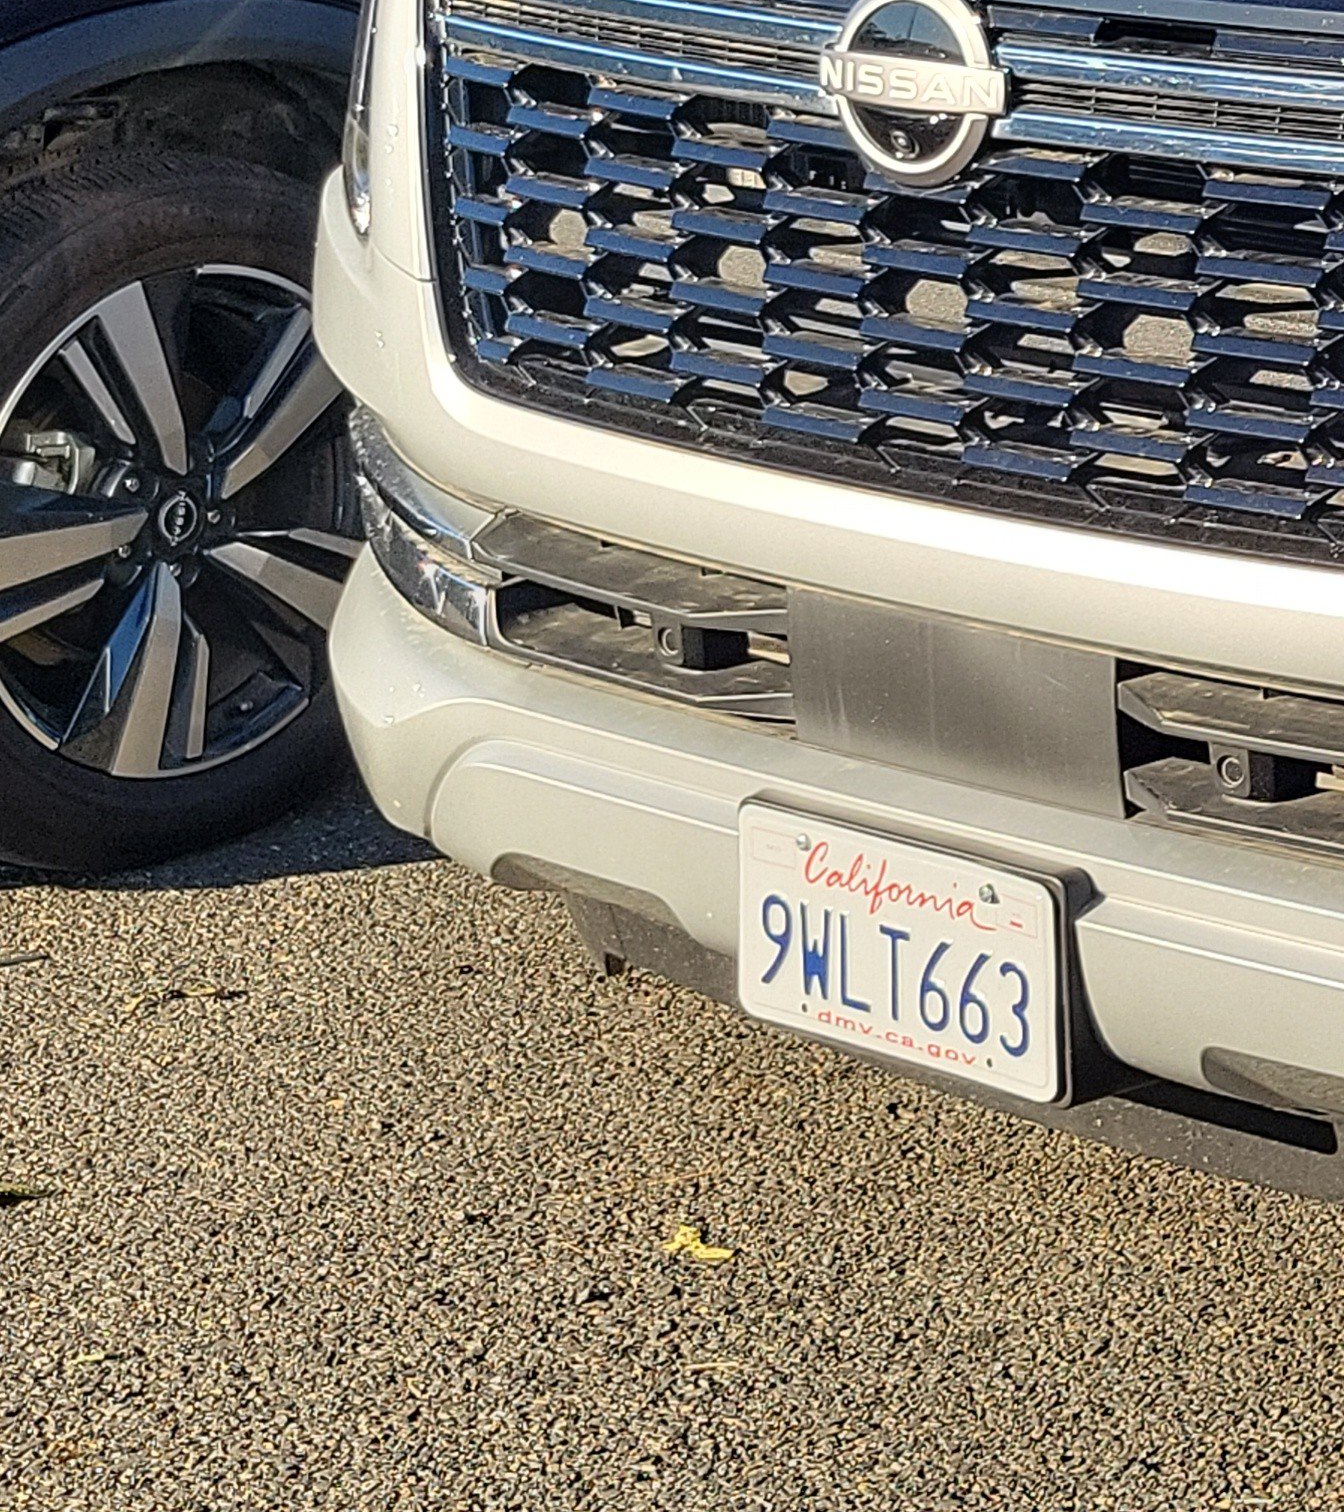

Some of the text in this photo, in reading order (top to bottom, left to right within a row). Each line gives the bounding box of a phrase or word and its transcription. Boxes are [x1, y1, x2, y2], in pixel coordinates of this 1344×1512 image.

[820, 55, 999, 110] NISSAN
[804, 840, 997, 931] California
[761, 893, 1031, 1058] 9WLT663
[817, 1008, 978, 1067] dmv.ca.gov
